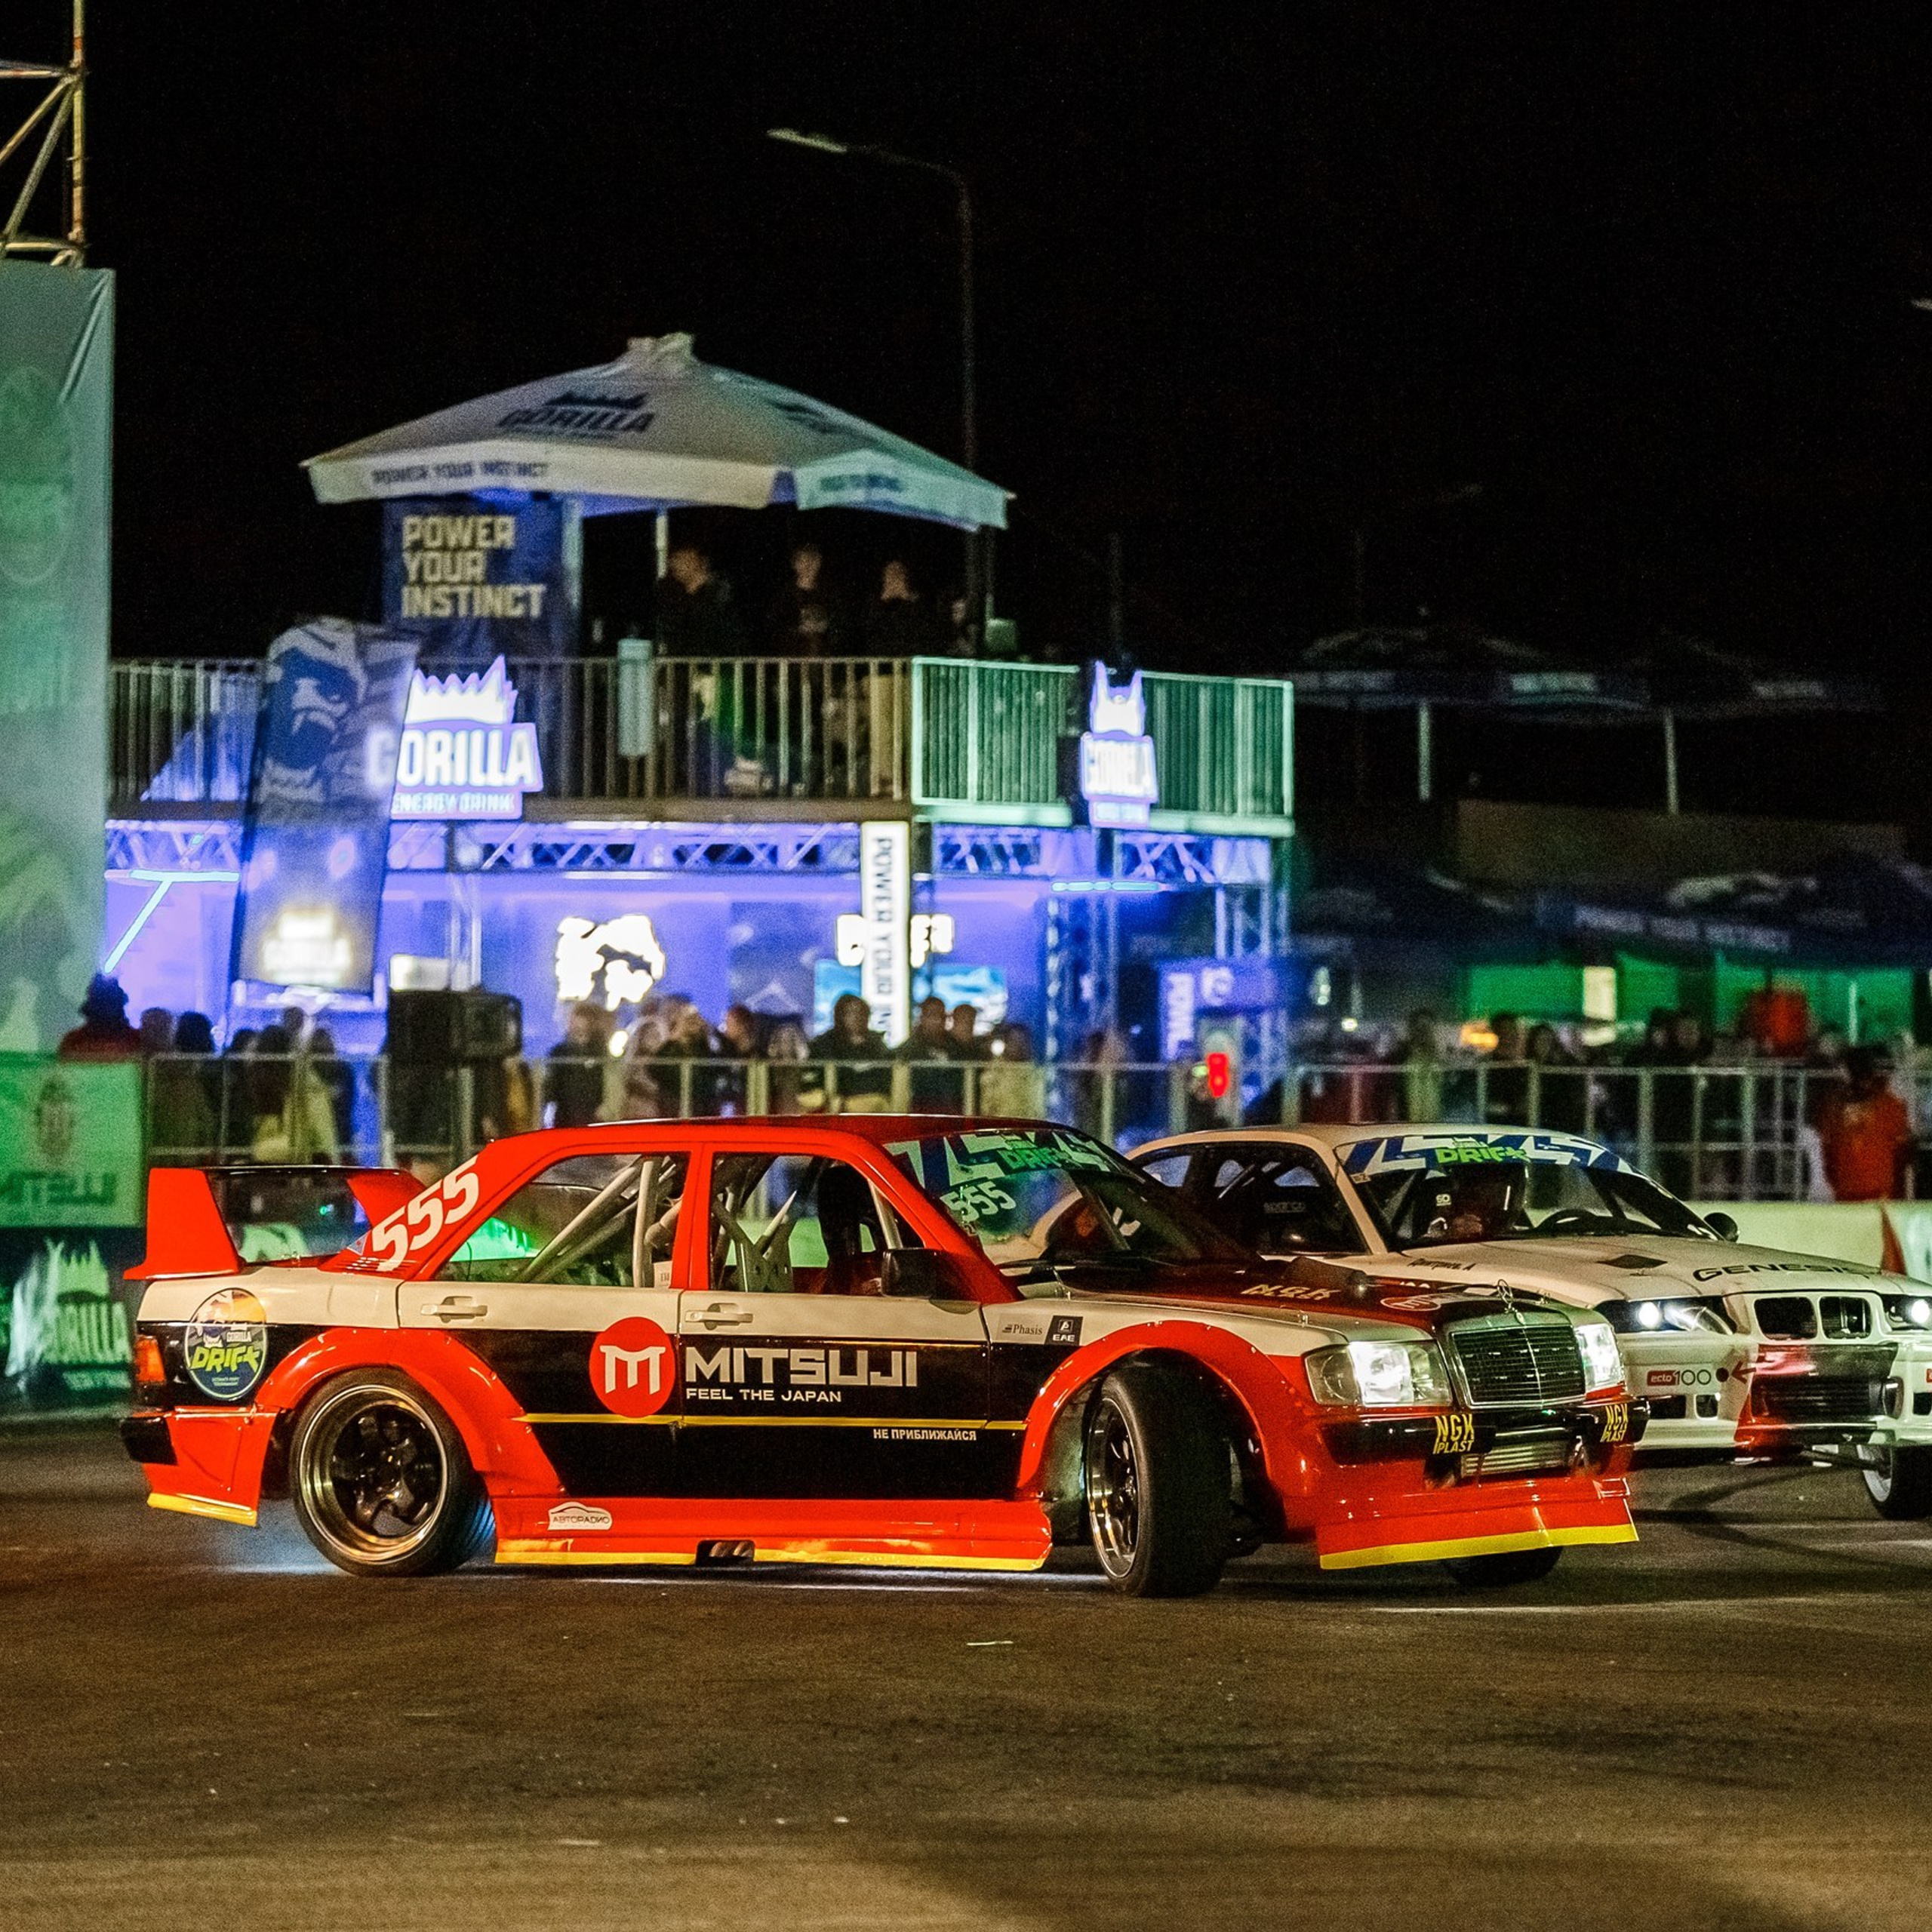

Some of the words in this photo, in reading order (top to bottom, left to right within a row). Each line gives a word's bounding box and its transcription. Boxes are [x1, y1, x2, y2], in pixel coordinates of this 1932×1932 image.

[402, 515, 515, 549] POWER
[402, 550, 486, 583] YOUR
[401, 584, 546, 618] INSTINCT
[365, 724, 538, 787] GORILLA
[372, 1155, 480, 1272] 555
[940, 1181, 1017, 1223] 555
[1013, 1324, 1043, 1335] Phasis
[190, 1346, 260, 1374] DRIFT
[685, 1346, 918, 1387] MITSUJI
[685, 1388, 734, 1401] FEEL
[740, 1389, 775, 1401] THE
[781, 1389, 842, 1403] JAPAN
[873, 1429, 889, 1439] НЕ
[891, 1429, 977, 1441] ПРИБЛИЖАЙСЯ
